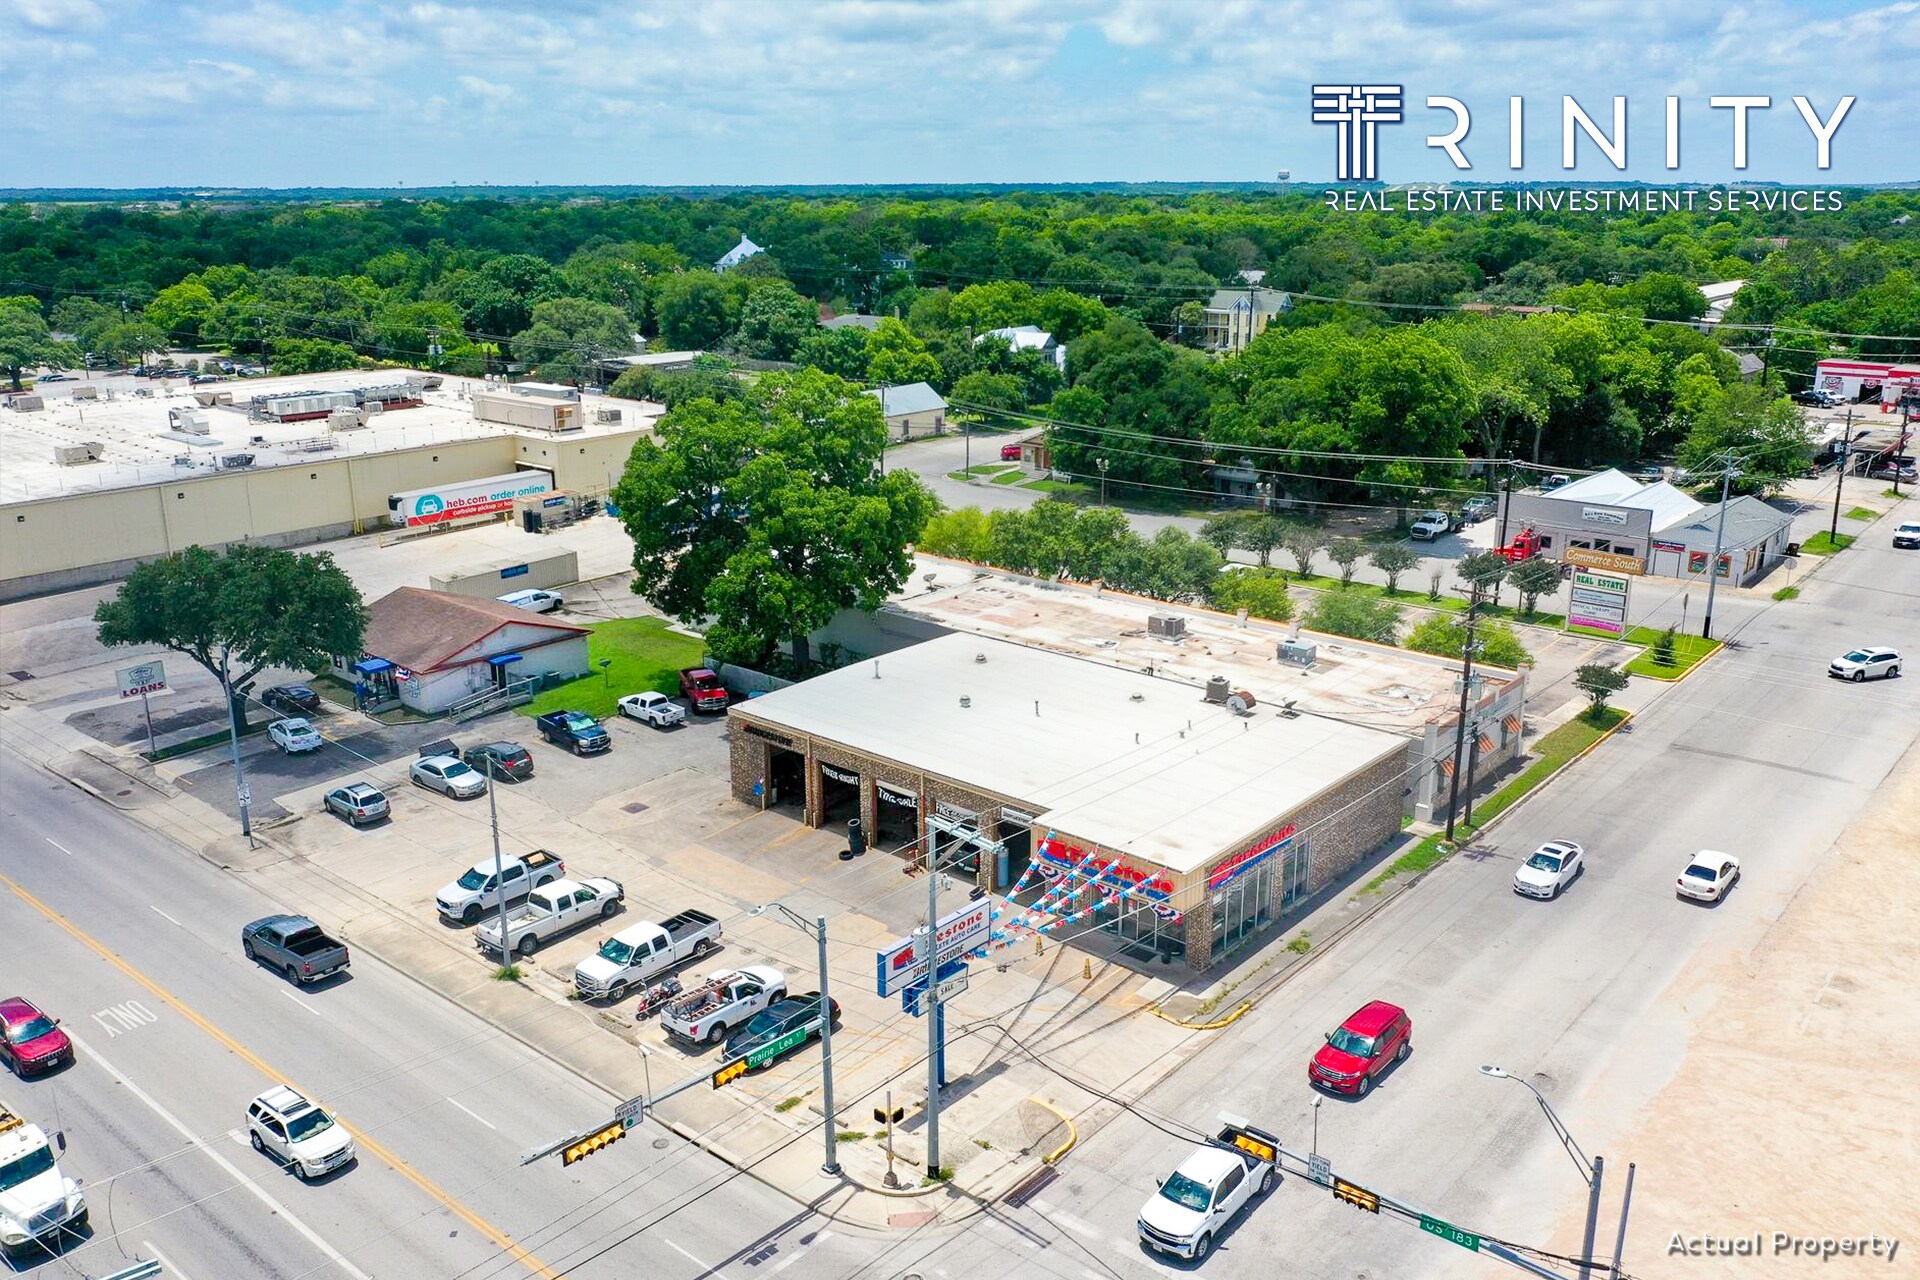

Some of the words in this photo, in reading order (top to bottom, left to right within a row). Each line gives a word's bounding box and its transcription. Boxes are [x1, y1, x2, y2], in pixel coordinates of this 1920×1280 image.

[446, 495, 488, 509] heb.com
[490, 490, 515, 501] order
[518, 484, 546, 497] online
[1566, 549, 1612, 566] Commerce
[1613, 557, 1641, 571] South
[1576, 575, 1594, 585] REAL
[1597, 578, 1625, 590] ESTATE
[123, 681, 165, 698] LOANS
[936, 911, 983, 942] estone
[950, 930, 966, 943] AUTO
[91, 1000, 158, 1038] ONLY
[748, 1047, 774, 1066] Prairie
[779, 1038, 793, 1050] Lea
[1311, 1161, 1328, 1172] YIELD
[1451, 1230, 1473, 1247] 183
